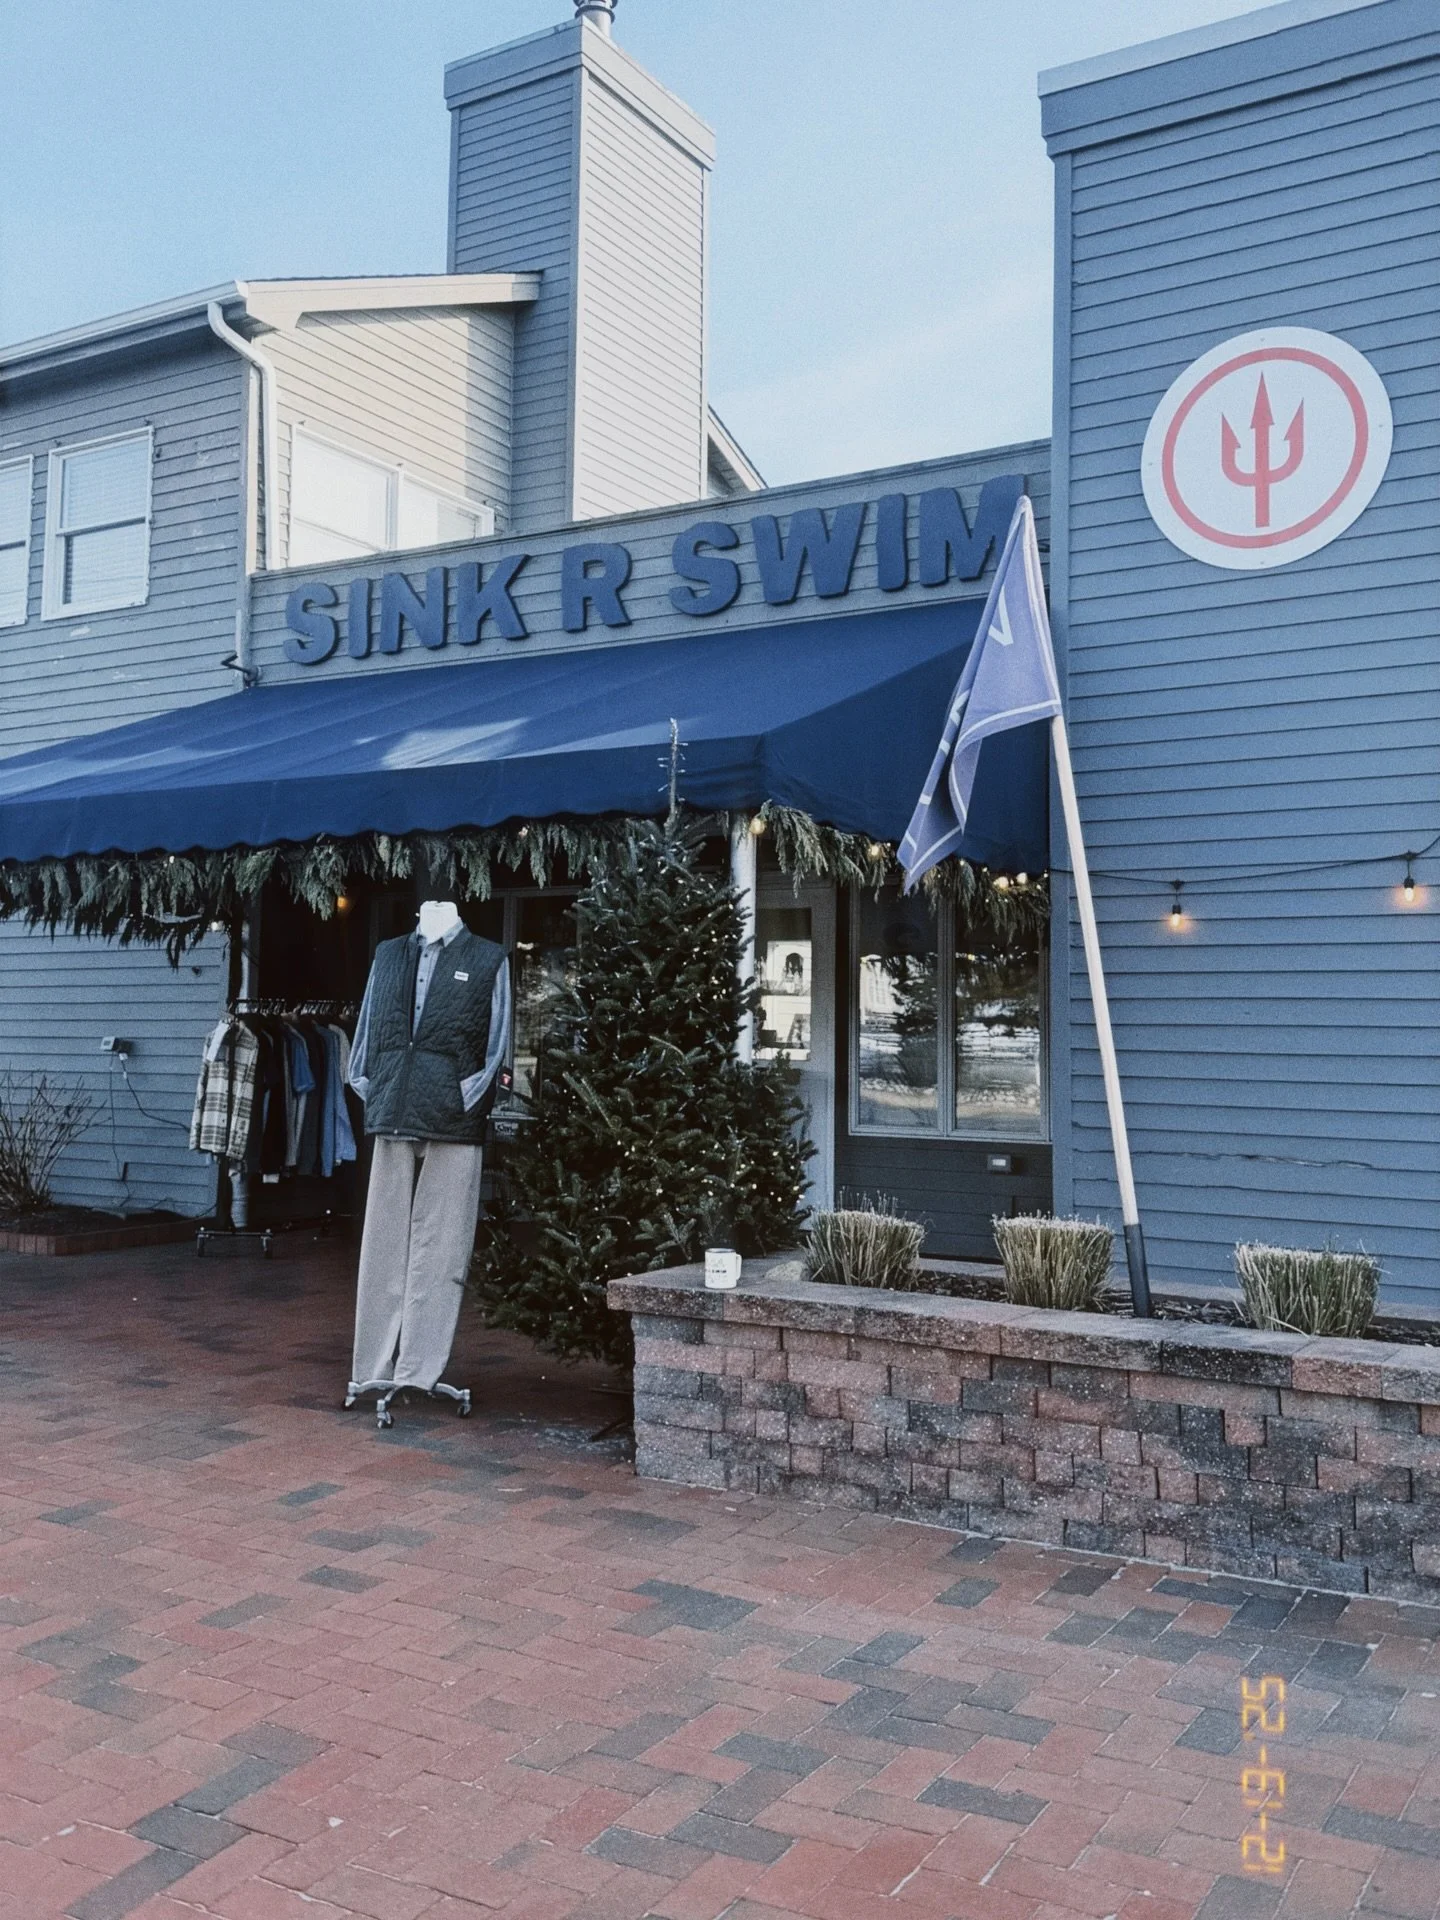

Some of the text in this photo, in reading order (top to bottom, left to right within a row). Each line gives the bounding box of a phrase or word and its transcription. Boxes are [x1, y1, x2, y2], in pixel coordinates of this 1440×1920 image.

[282, 473, 1026, 665] SINK R SWIM
